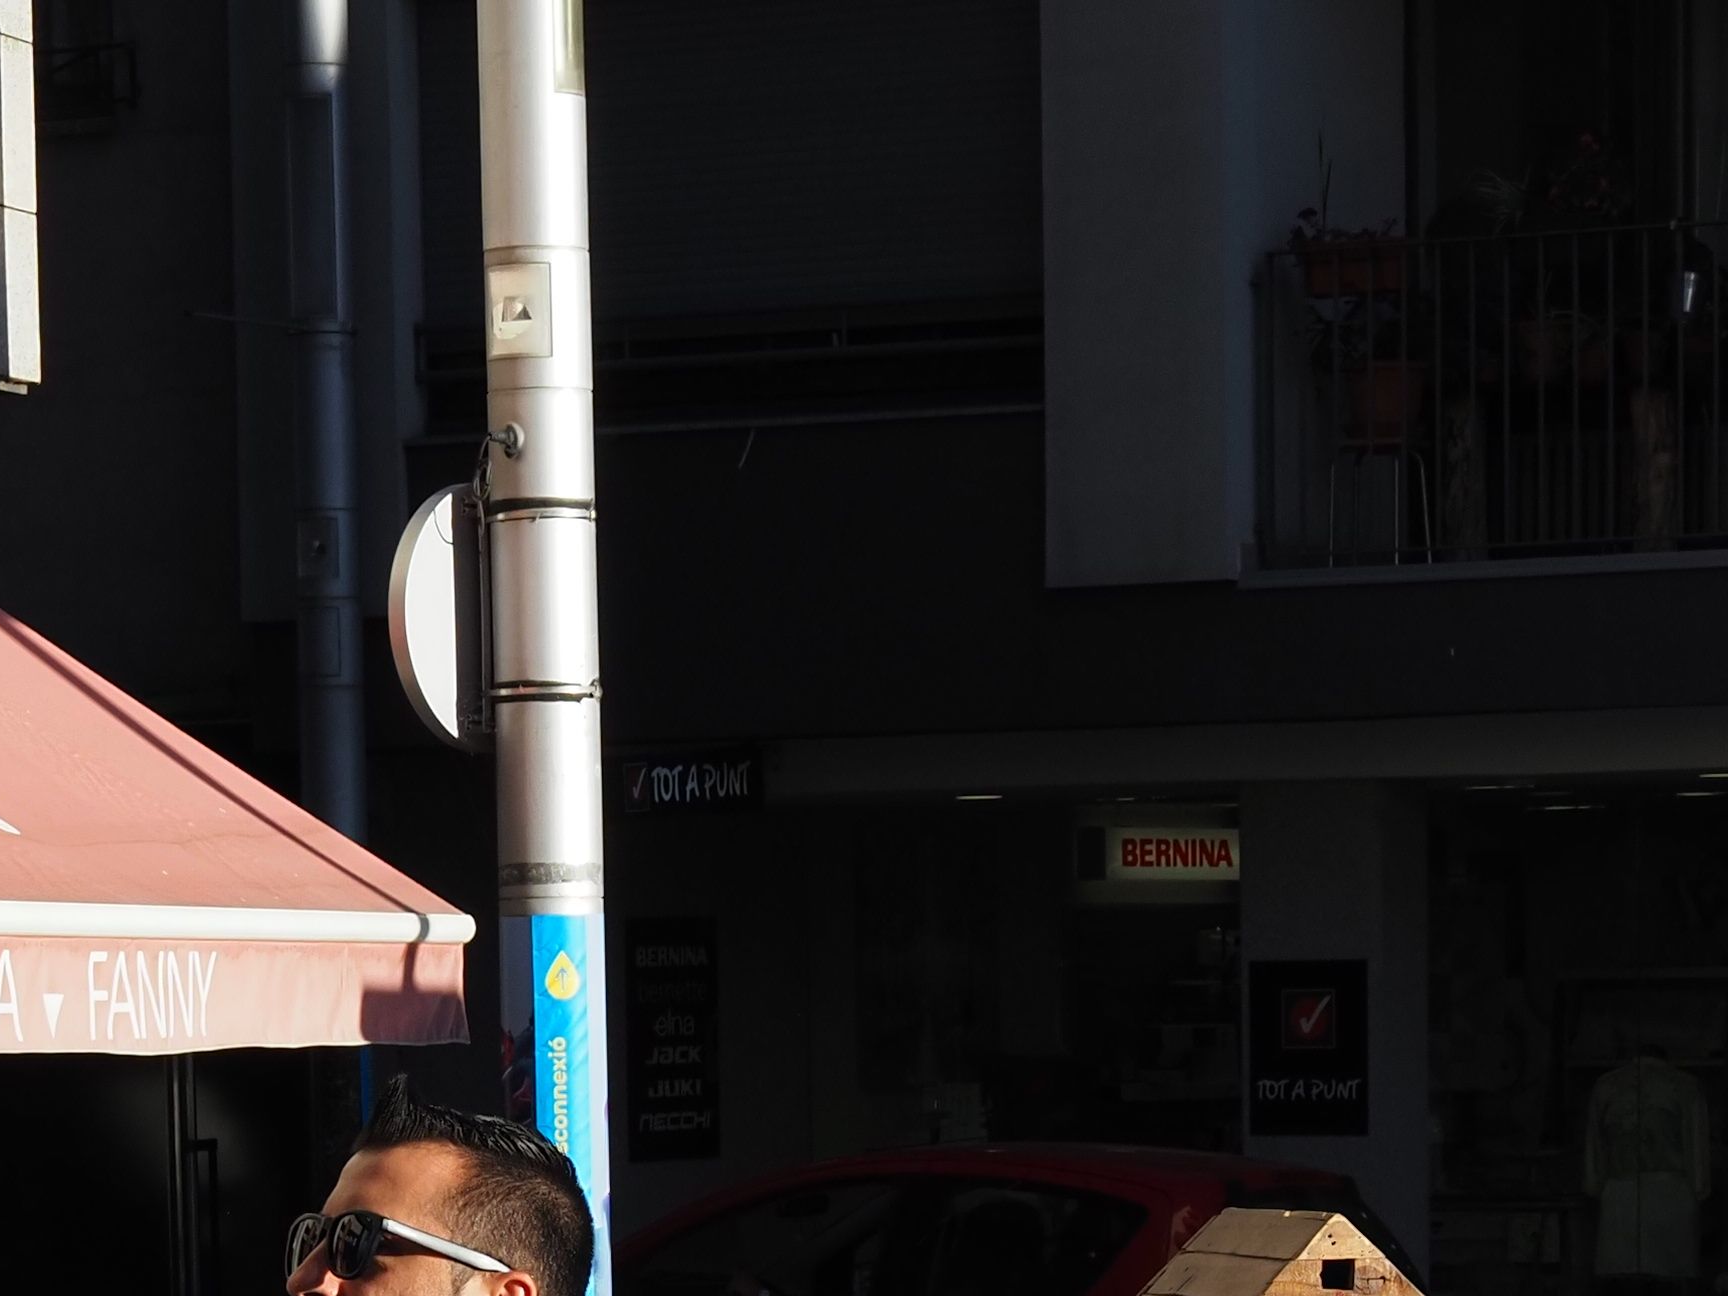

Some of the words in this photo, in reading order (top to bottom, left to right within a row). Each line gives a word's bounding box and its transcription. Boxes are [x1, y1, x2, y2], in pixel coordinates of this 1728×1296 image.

[651, 764, 683, 803] TOT
[685, 763, 700, 803] A
[702, 760, 752, 801] PUNT
[1121, 838, 1233, 868] BERNINA
[635, 944, 710, 969] BERNINA
[87, 949, 218, 1041] FANNY
[654, 1007, 696, 1037] elna
[647, 1078, 704, 1098] JUKI
[1256, 1078, 1290, 1101] TOT
[1290, 1078, 1306, 1102] A
[1310, 1078, 1363, 1102] PUNT
